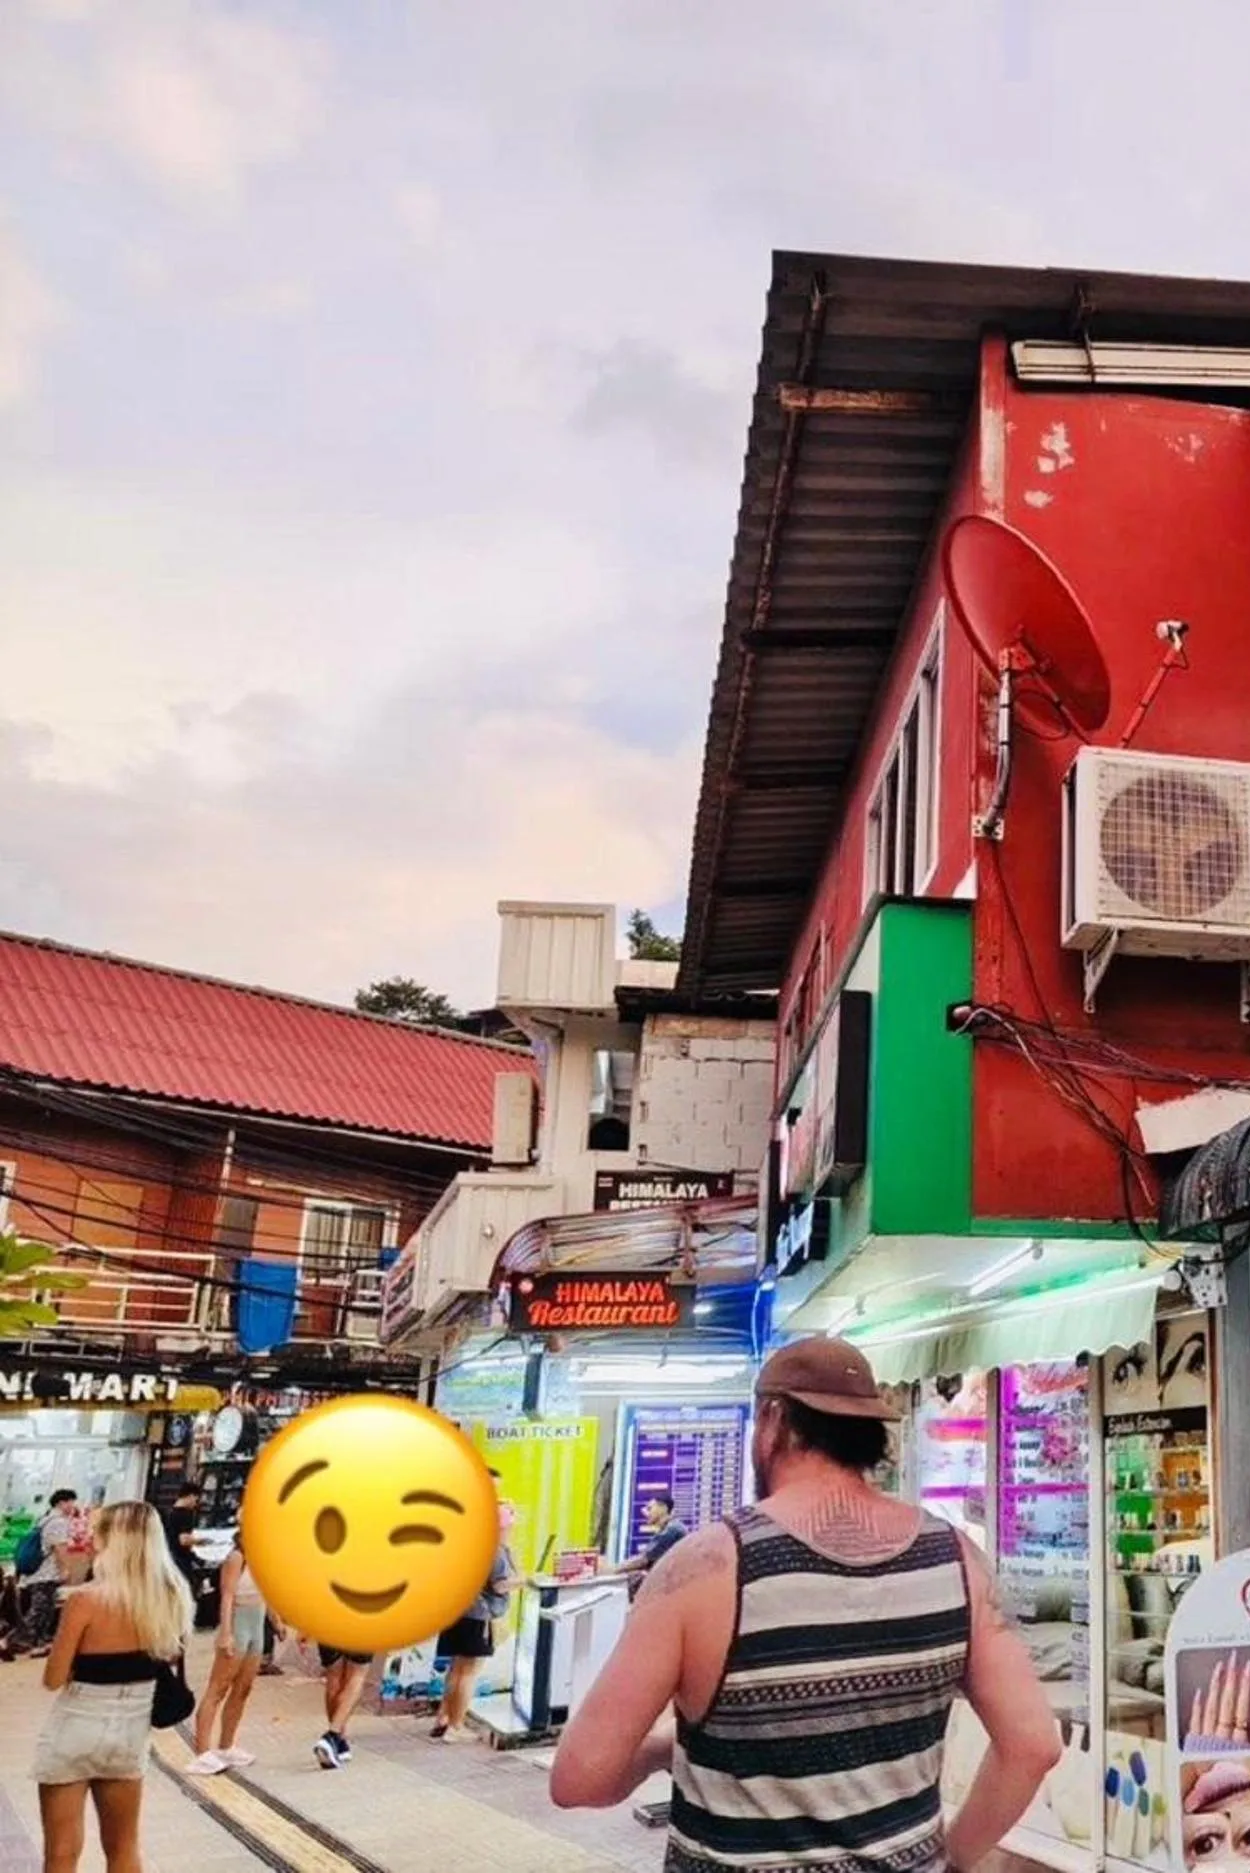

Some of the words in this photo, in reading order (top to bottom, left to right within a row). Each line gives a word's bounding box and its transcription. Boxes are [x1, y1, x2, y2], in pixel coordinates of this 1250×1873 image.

[618, 1181, 709, 1200] HIMALAYA
[557, 1281, 665, 1303] HIMALAYA
[528, 1300, 681, 1327] Restaurant
[61, 1371, 179, 1401] MART
[485, 1426, 527, 1440] BOAT
[531, 1424, 581, 1439] TICKET
